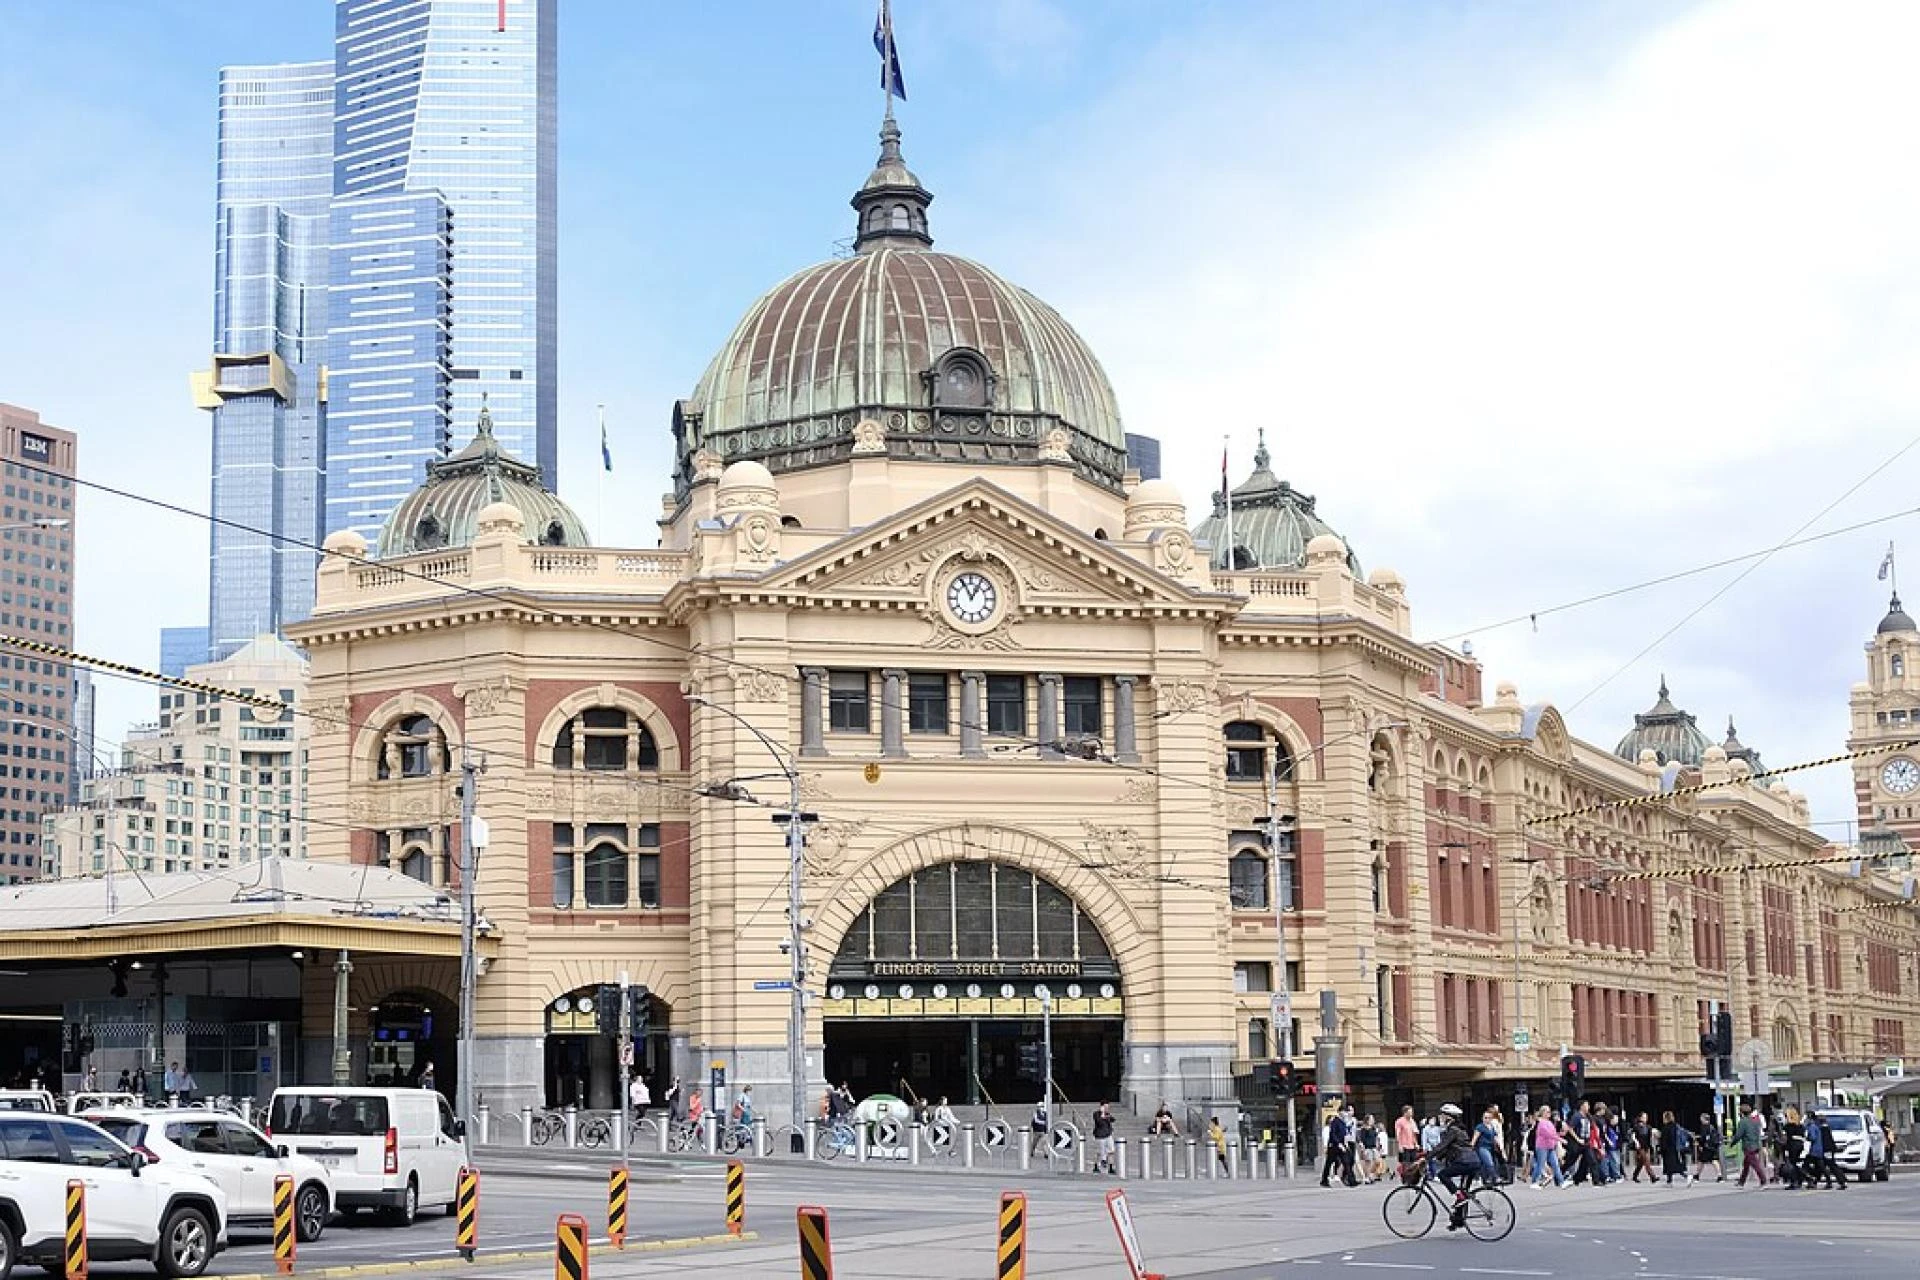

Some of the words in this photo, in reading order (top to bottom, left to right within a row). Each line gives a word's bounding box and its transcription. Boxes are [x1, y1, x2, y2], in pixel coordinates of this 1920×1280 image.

[24, 436, 47, 454] IBM
[873, 963, 940, 975] FLINDERS
[955, 963, 1006, 975] STREET
[1021, 963, 1079, 975] STATION
